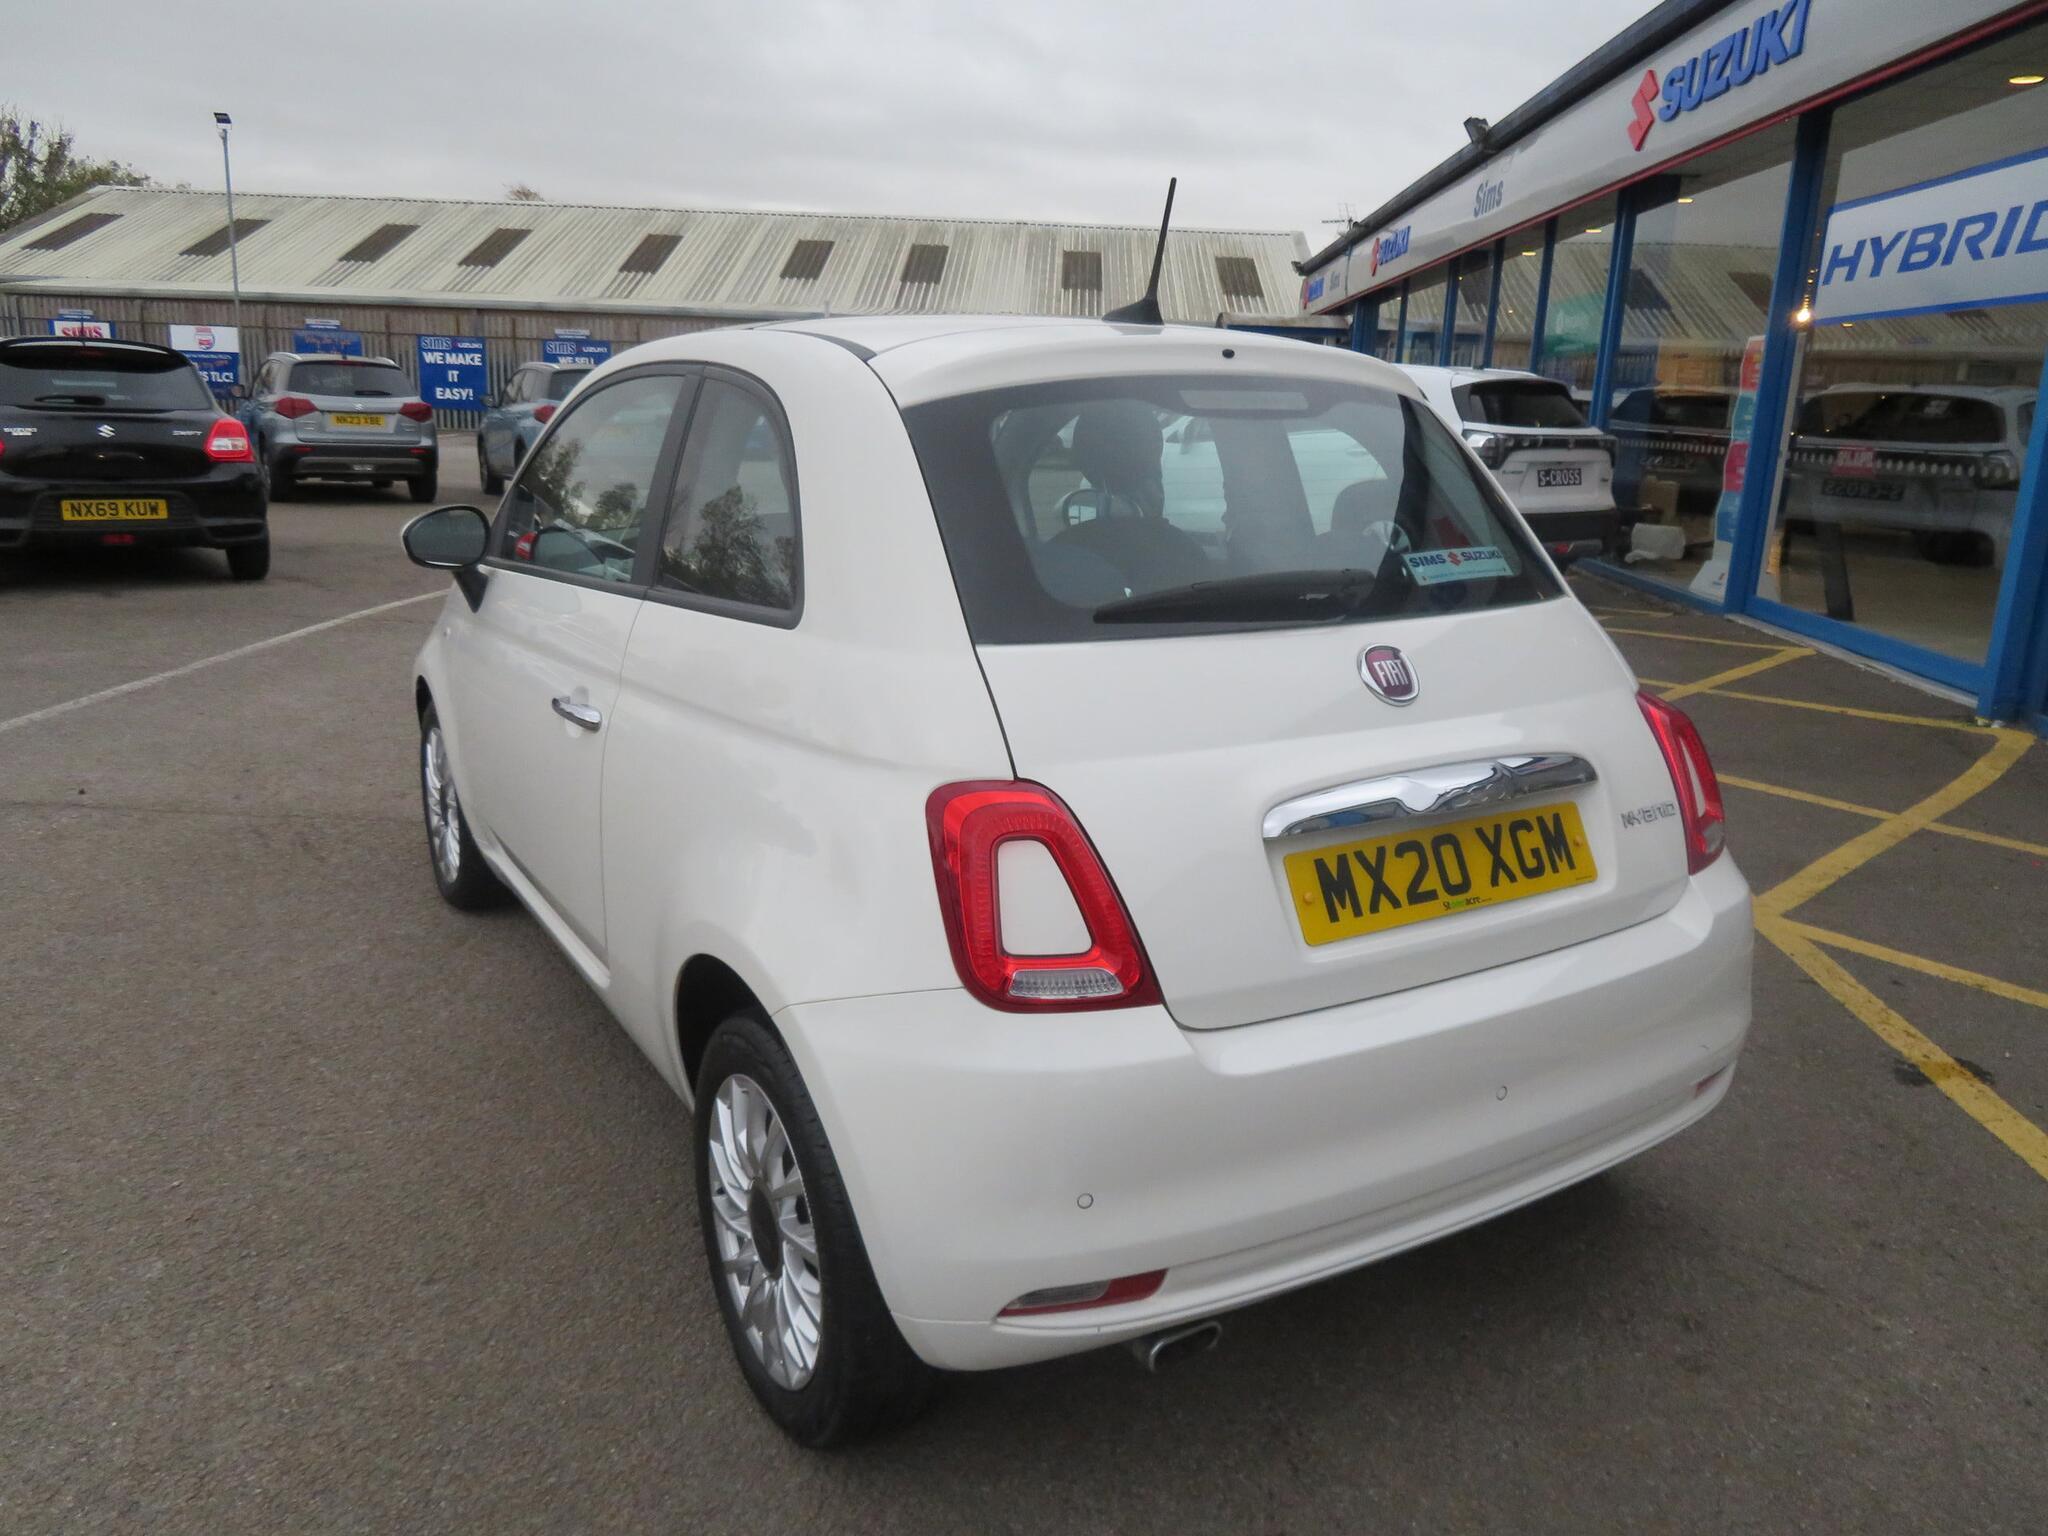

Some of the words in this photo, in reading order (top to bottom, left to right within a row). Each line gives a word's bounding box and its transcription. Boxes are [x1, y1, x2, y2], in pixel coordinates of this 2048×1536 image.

[1659, 0, 1811, 122] SUZUKI
[1474, 180, 1503, 218] Sims
[422, 351, 444, 365] WE
[445, 352, 482, 366] MAKE
[448, 370, 459, 382] IT
[435, 387, 474, 400] EASY!
[1539, 468, 1581, 487] S-CROSS
[70, 502, 119, 517] NX69
[123, 501, 160, 516] KUW
[1409, 554, 1447, 568] SIMS
[1372, 659, 1409, 688] FIAT
[1313, 833, 1472, 923] MX20
[1474, 812, 1577, 889] XGM
